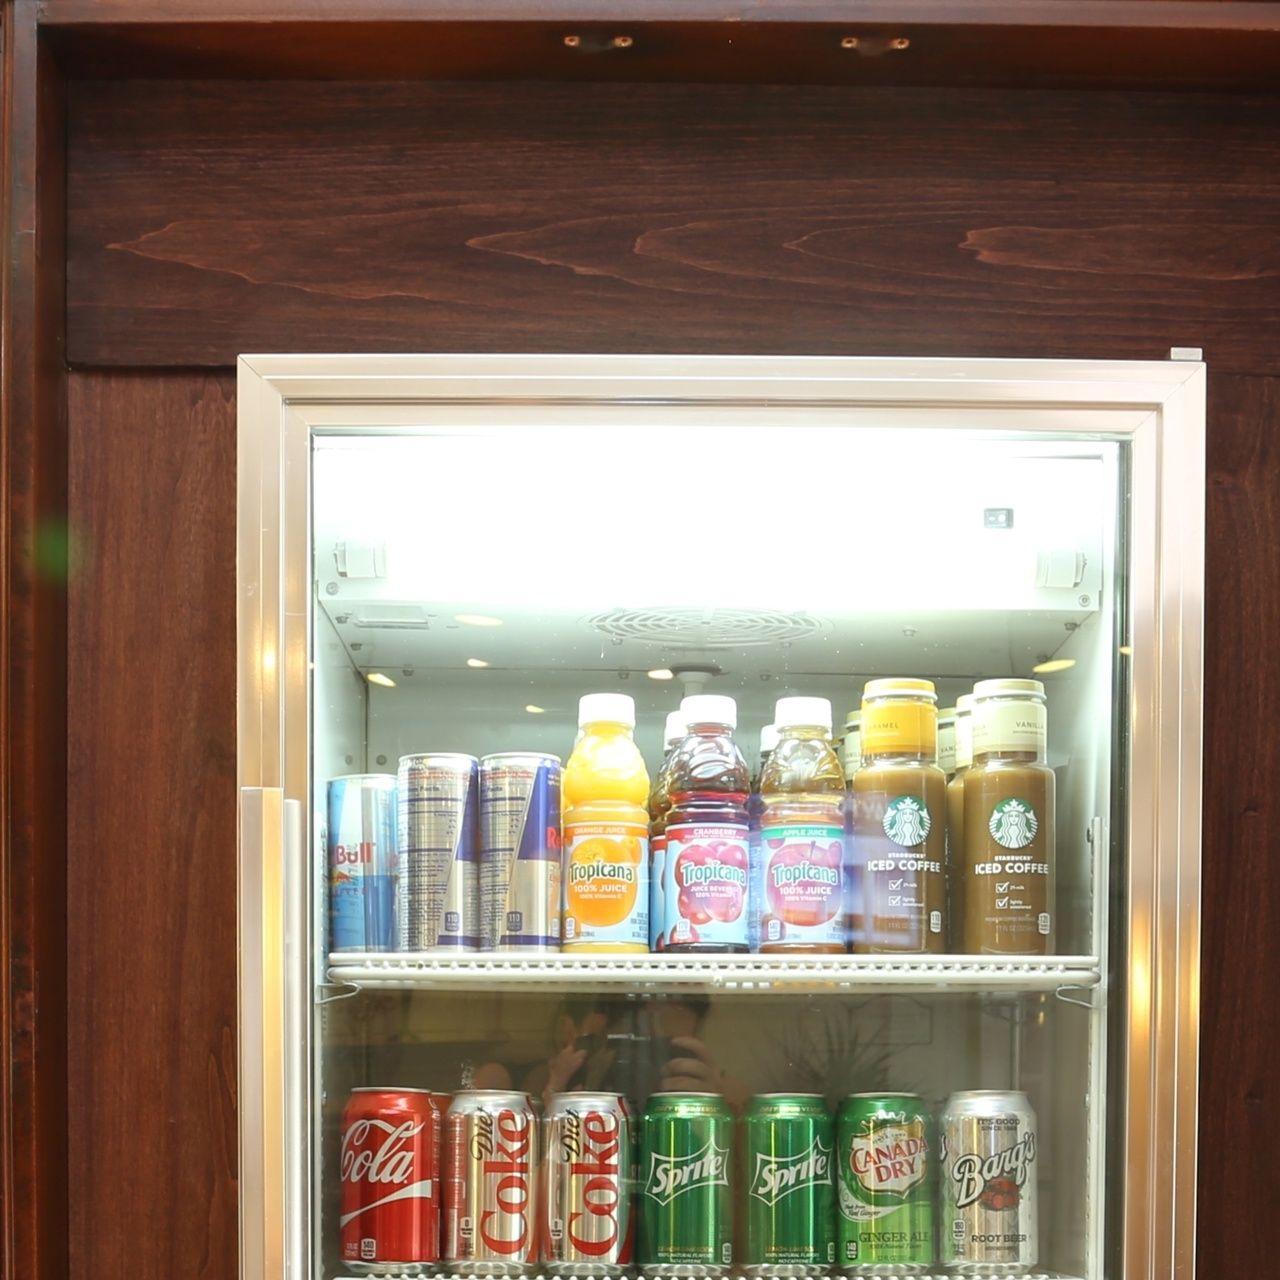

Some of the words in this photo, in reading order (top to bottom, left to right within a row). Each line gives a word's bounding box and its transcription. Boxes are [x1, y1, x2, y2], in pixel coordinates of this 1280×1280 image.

[693, 828, 738, 836] CRANBERRY
[570, 860, 633, 884] Tropicana
[681, 861, 746, 886] Tropicana
[773, 861, 838, 886] Tropicana
[867, 860, 895, 872] ICED
[898, 860, 941, 873] COFFEE
[975, 863, 1002, 875] ICED
[1005, 862, 1049, 875] COFFEE
[574, 885, 597, 893] 100%
[599, 884, 628, 893] JUICE
[780, 886, 803, 895] 100%
[805, 886, 832, 895] JUICE
[471, 1105, 493, 1161] Diet
[995, 1118, 1021, 1126] GOOD
[561, 1108, 581, 1162] Diet
[340, 1118, 425, 1184] Cola
[850, 1136, 928, 1175] CANADA
[480, 1109, 531, 1256] Coke
[652, 1151, 723, 1196] Sprite
[758, 1149, 827, 1196] Sprite
[874, 1157, 917, 1184] DRY
[952, 1131, 1036, 1210] Barq's
[569, 1110, 620, 1257] Coke
[859, 1231, 906, 1242] GINGER
[971, 1235, 1001, 1243] ROOT
[1003, 1234, 1028, 1242] BEER
